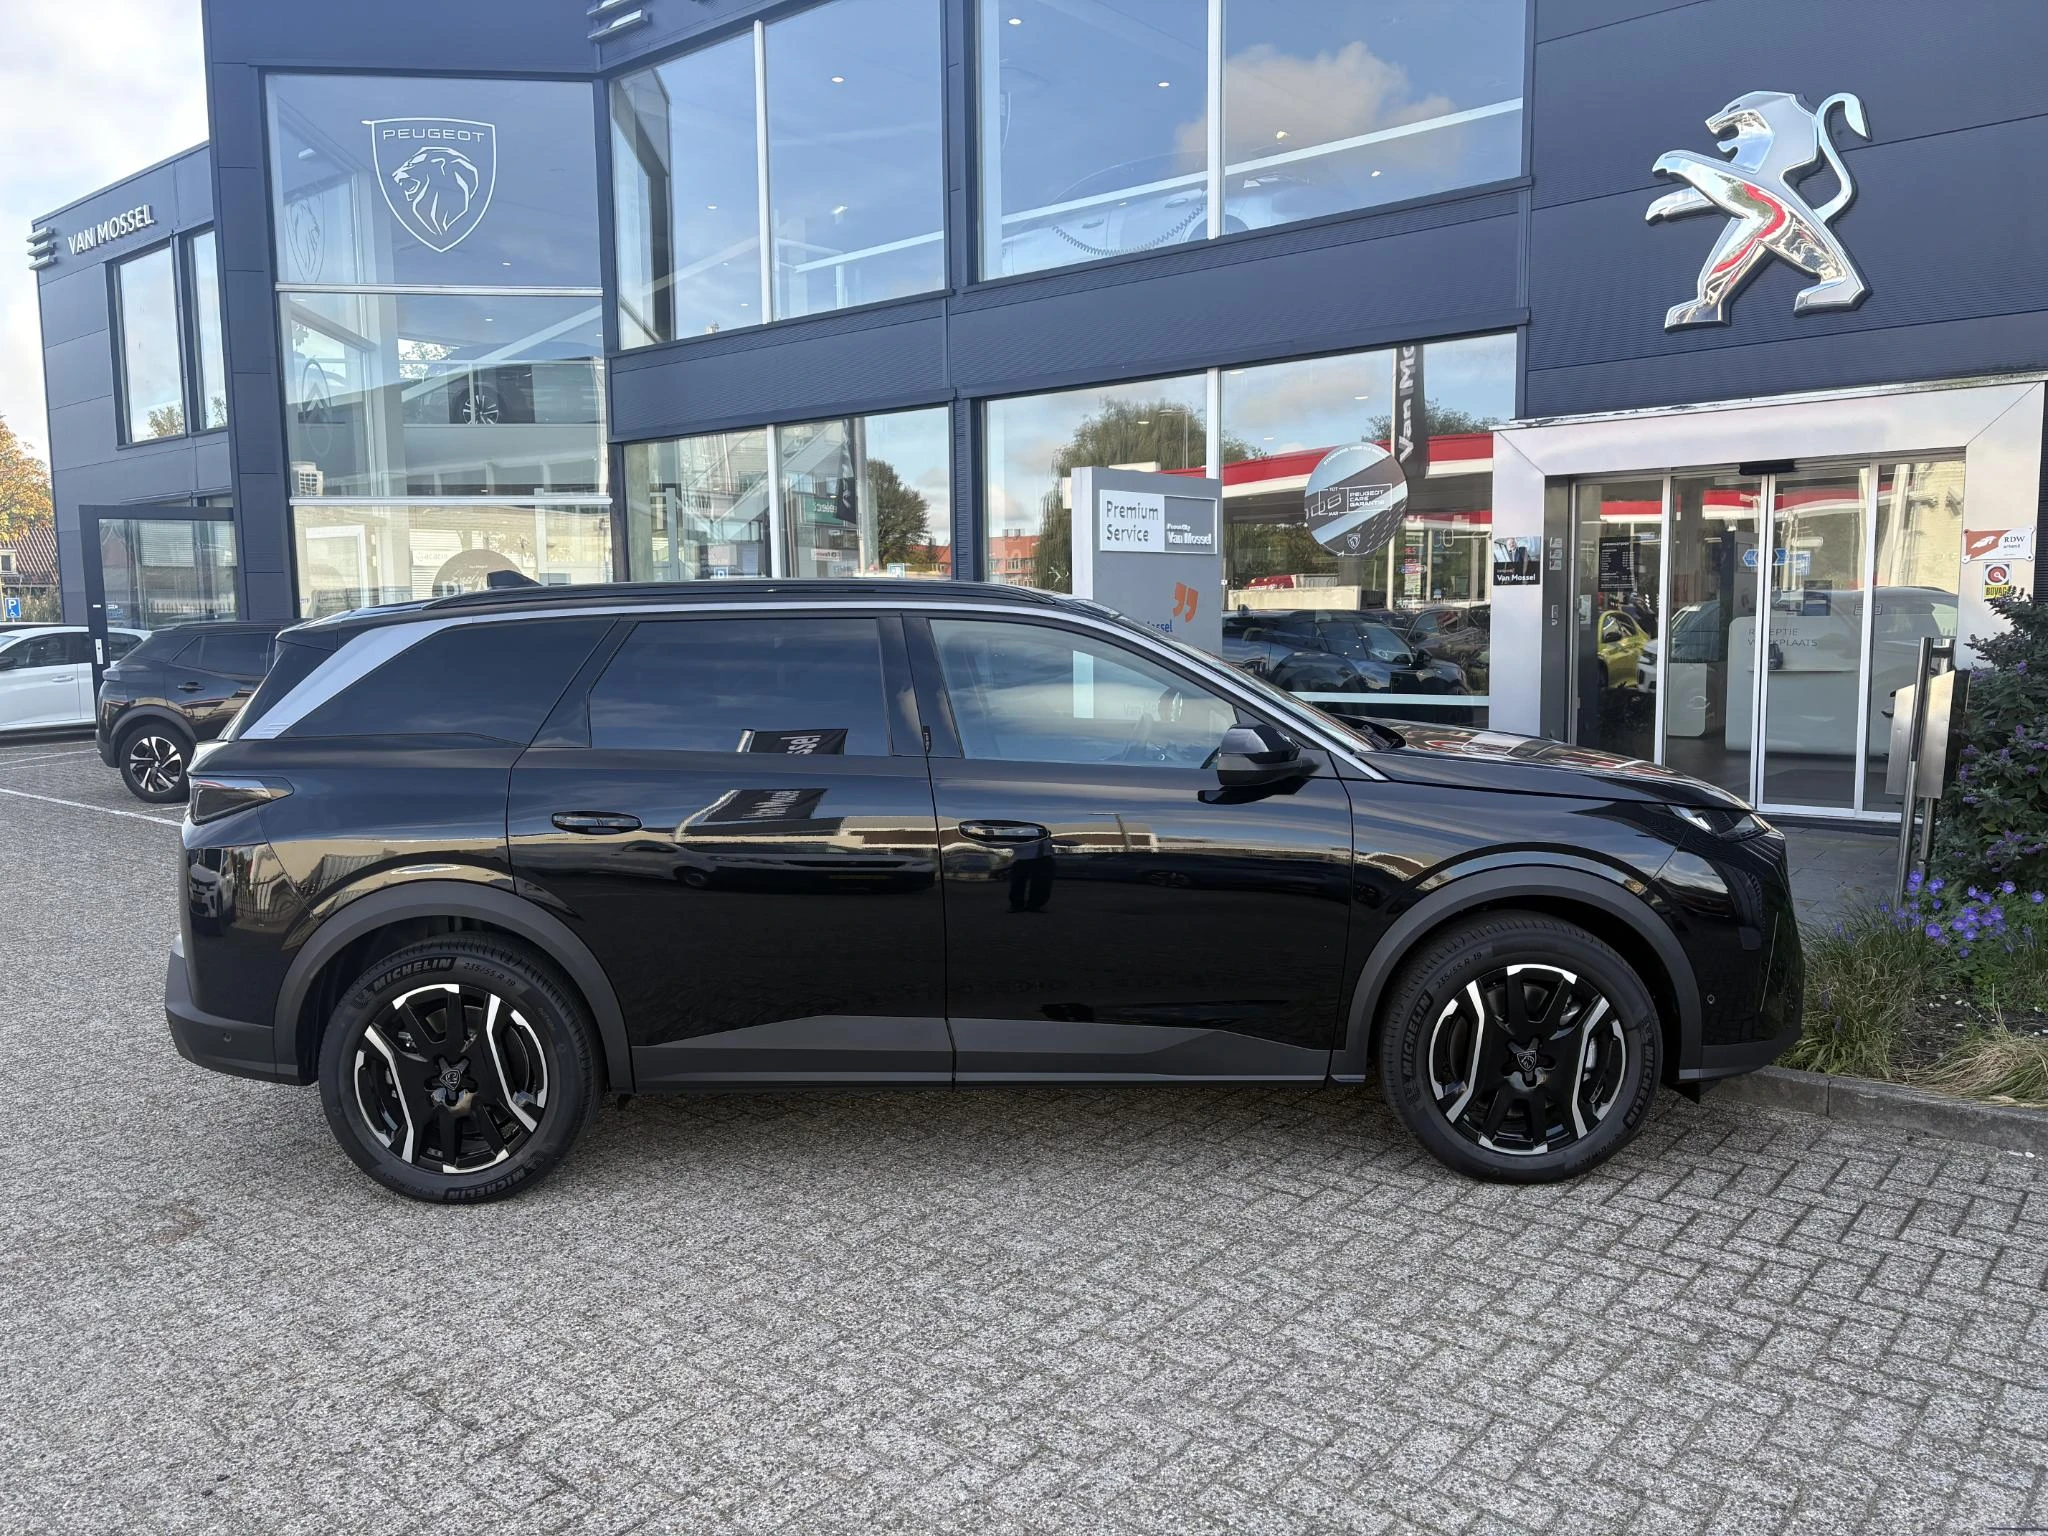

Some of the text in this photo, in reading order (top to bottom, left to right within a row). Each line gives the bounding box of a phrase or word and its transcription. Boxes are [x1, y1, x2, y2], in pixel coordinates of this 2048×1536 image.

[383, 128, 485, 142] PEUGEOT
[68, 205, 154, 255] VAN MOSSEL
[1106, 500, 1159, 520] Premium
[1106, 524, 1149, 542] Service
[1167, 531, 1212, 545] Van Mossel
[2004, 535, 2025, 543] RDW
[1496, 573, 1536, 582] Van Mossel
[8, 599, 17, 609] P
[1748, 628, 1799, 636] REPTIE
[373, 958, 452, 992] MICHELIN
[1403, 993, 1432, 1077] MICHELIN
[1627, 1042, 1656, 1127] MICHELIN
[447, 1159, 527, 1200] MICHELIN
